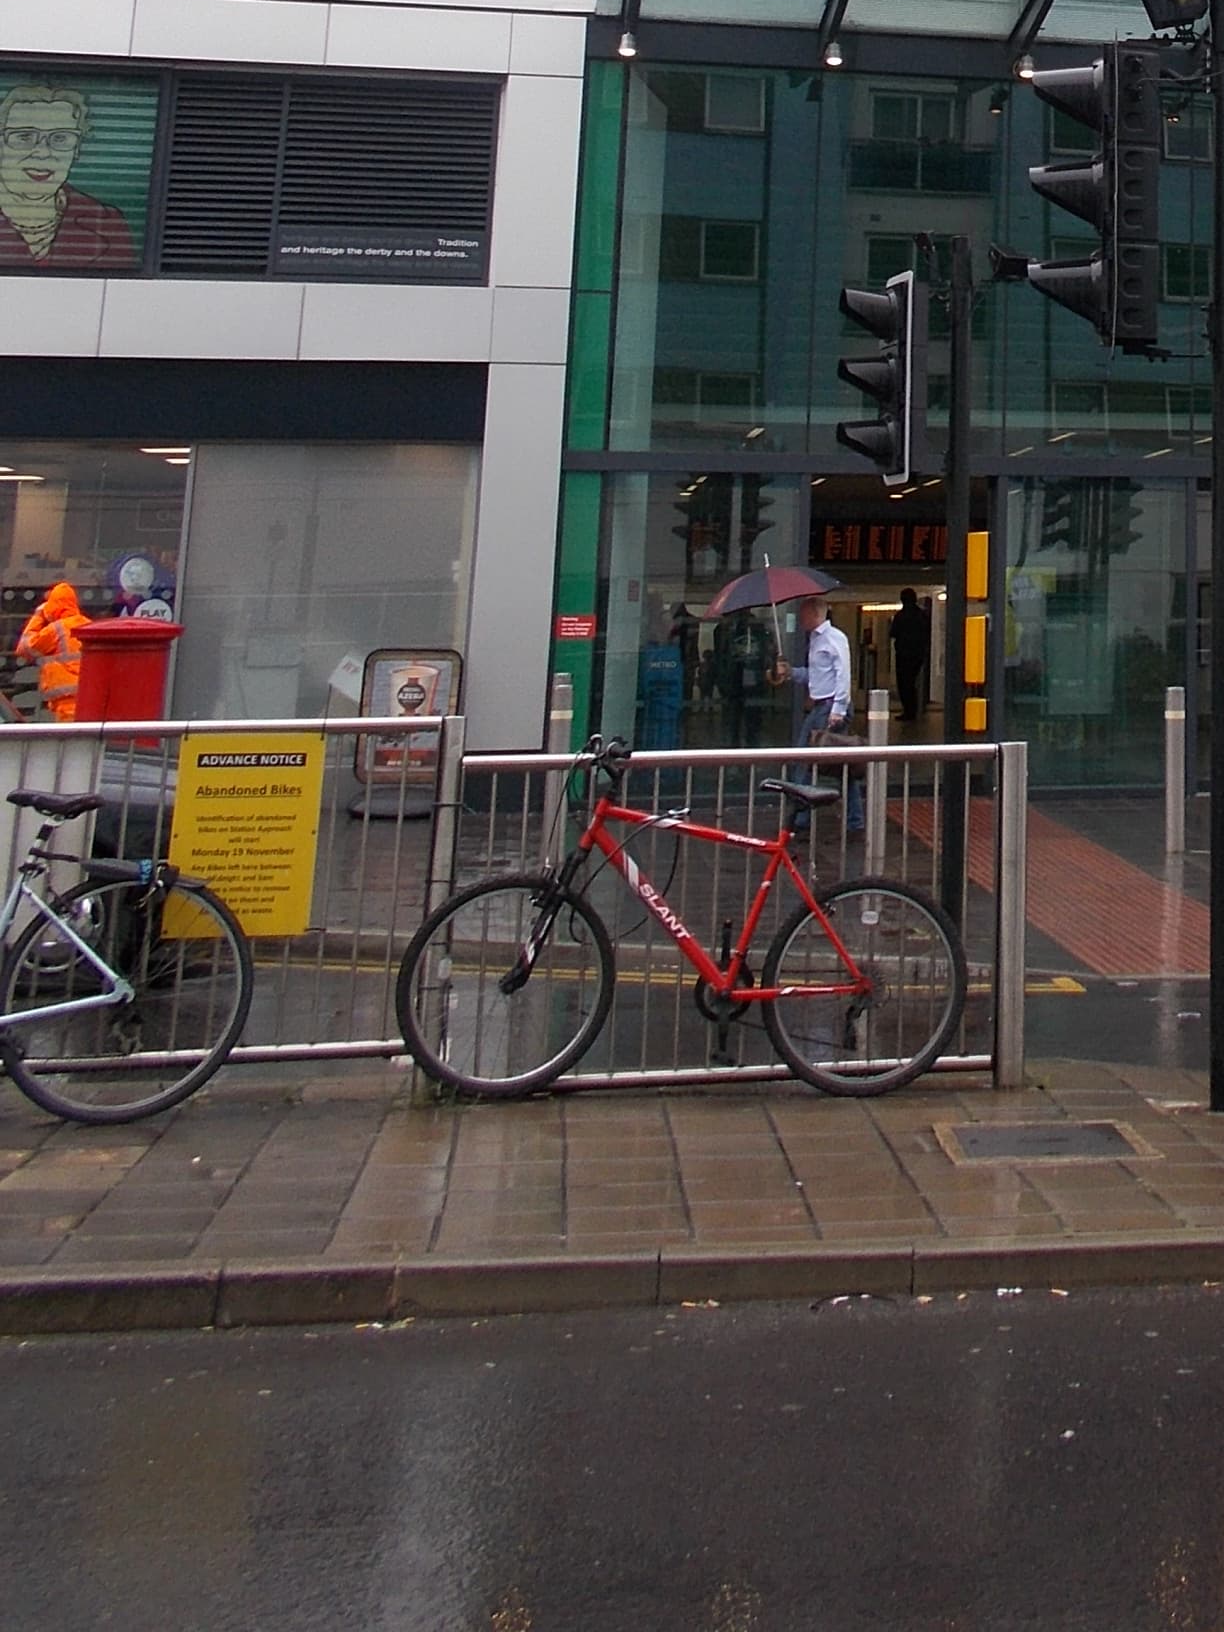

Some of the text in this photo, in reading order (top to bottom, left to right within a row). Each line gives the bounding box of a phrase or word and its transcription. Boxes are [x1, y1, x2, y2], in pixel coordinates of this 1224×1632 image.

[437, 237, 479, 248] Tradition
[280, 246, 469, 258] and heritage the derby and the downs.
[140, 609, 167, 618] PLAY
[200, 754, 304, 766] ADVANCE NOTICE
[196, 784, 303, 797] Abandoned Bikes
[192, 847, 295, 858] Monday 19 November
[639, 883, 692, 940] SLANT
